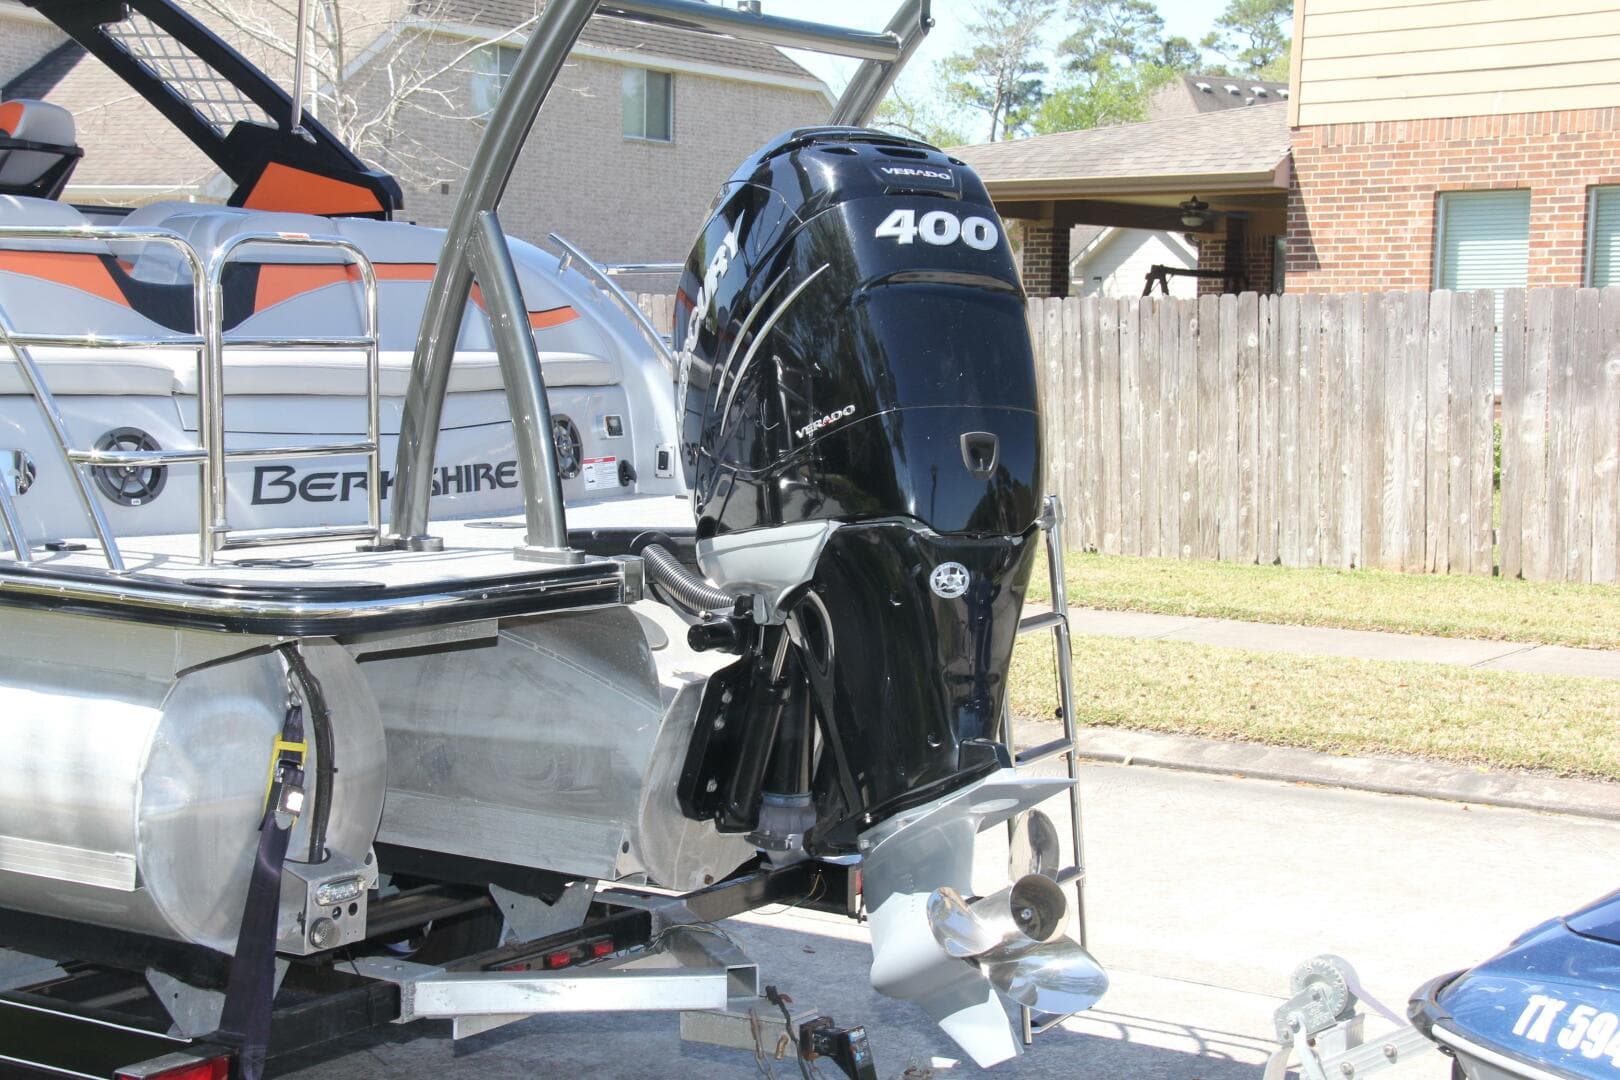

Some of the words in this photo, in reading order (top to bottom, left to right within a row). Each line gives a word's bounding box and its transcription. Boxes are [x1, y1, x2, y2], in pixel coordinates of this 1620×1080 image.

[881, 167, 952, 181] VERADO
[875, 208, 999, 251] 400
[676, 208, 746, 443] CURY
[795, 404, 856, 439] VERADO
[1511, 994, 1568, 1044] TX
